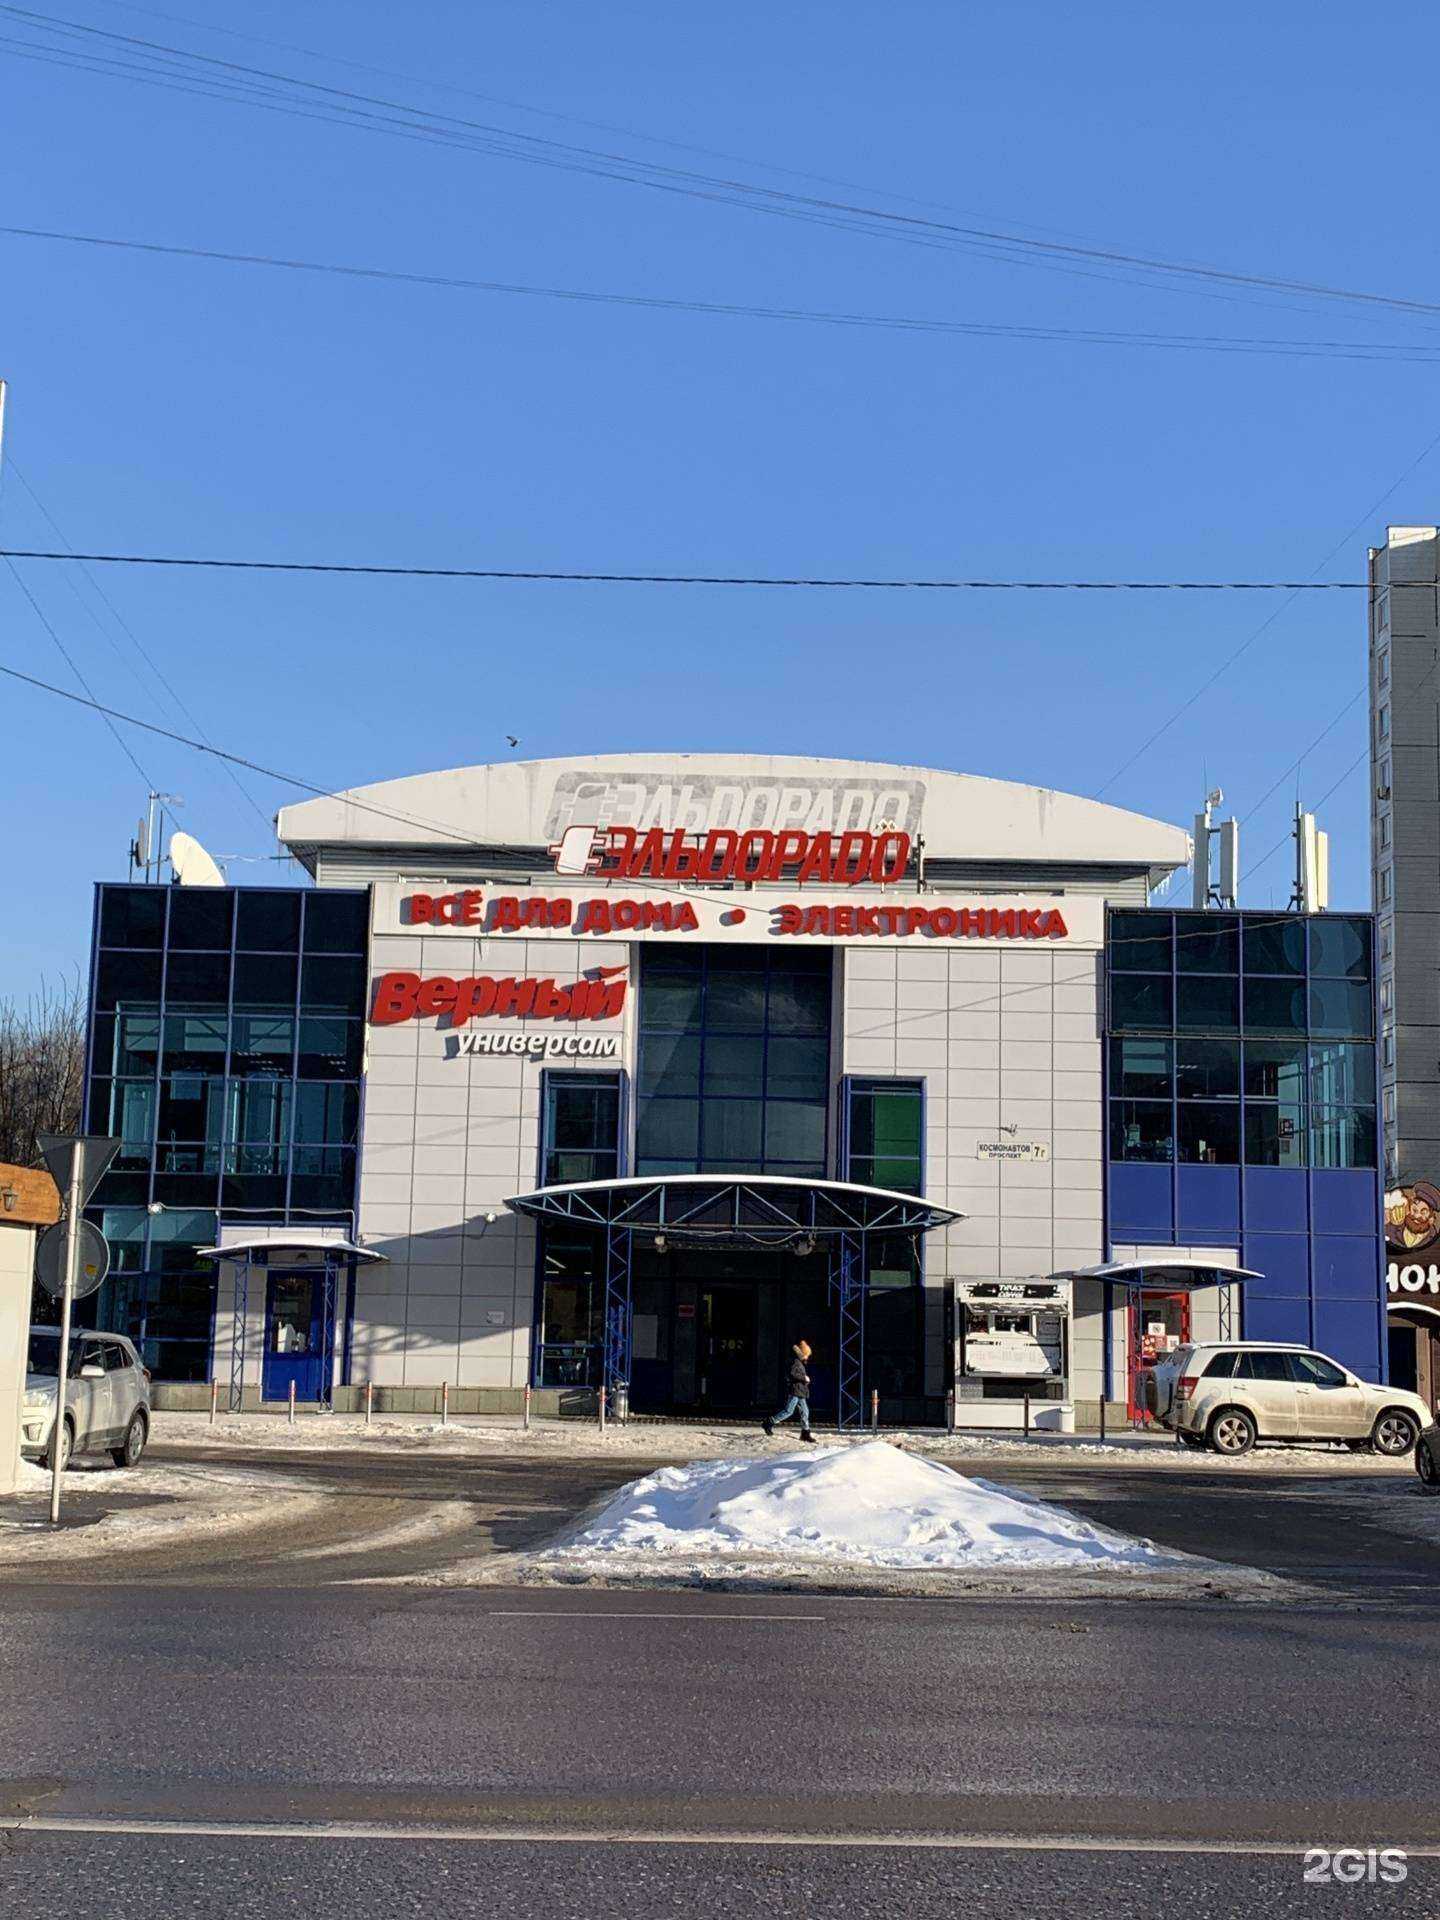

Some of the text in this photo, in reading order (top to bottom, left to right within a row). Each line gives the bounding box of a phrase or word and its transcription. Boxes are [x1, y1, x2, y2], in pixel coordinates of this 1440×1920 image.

[410, 889, 1069, 939] ВСЁ ДЛЯ ДОМА ЭЛЕКТРОНИКА
[368, 964, 630, 1026] Верный
[456, 1032, 620, 1058] универсам
[979, 1143, 1031, 1153] КОСМОНАВТОВ
